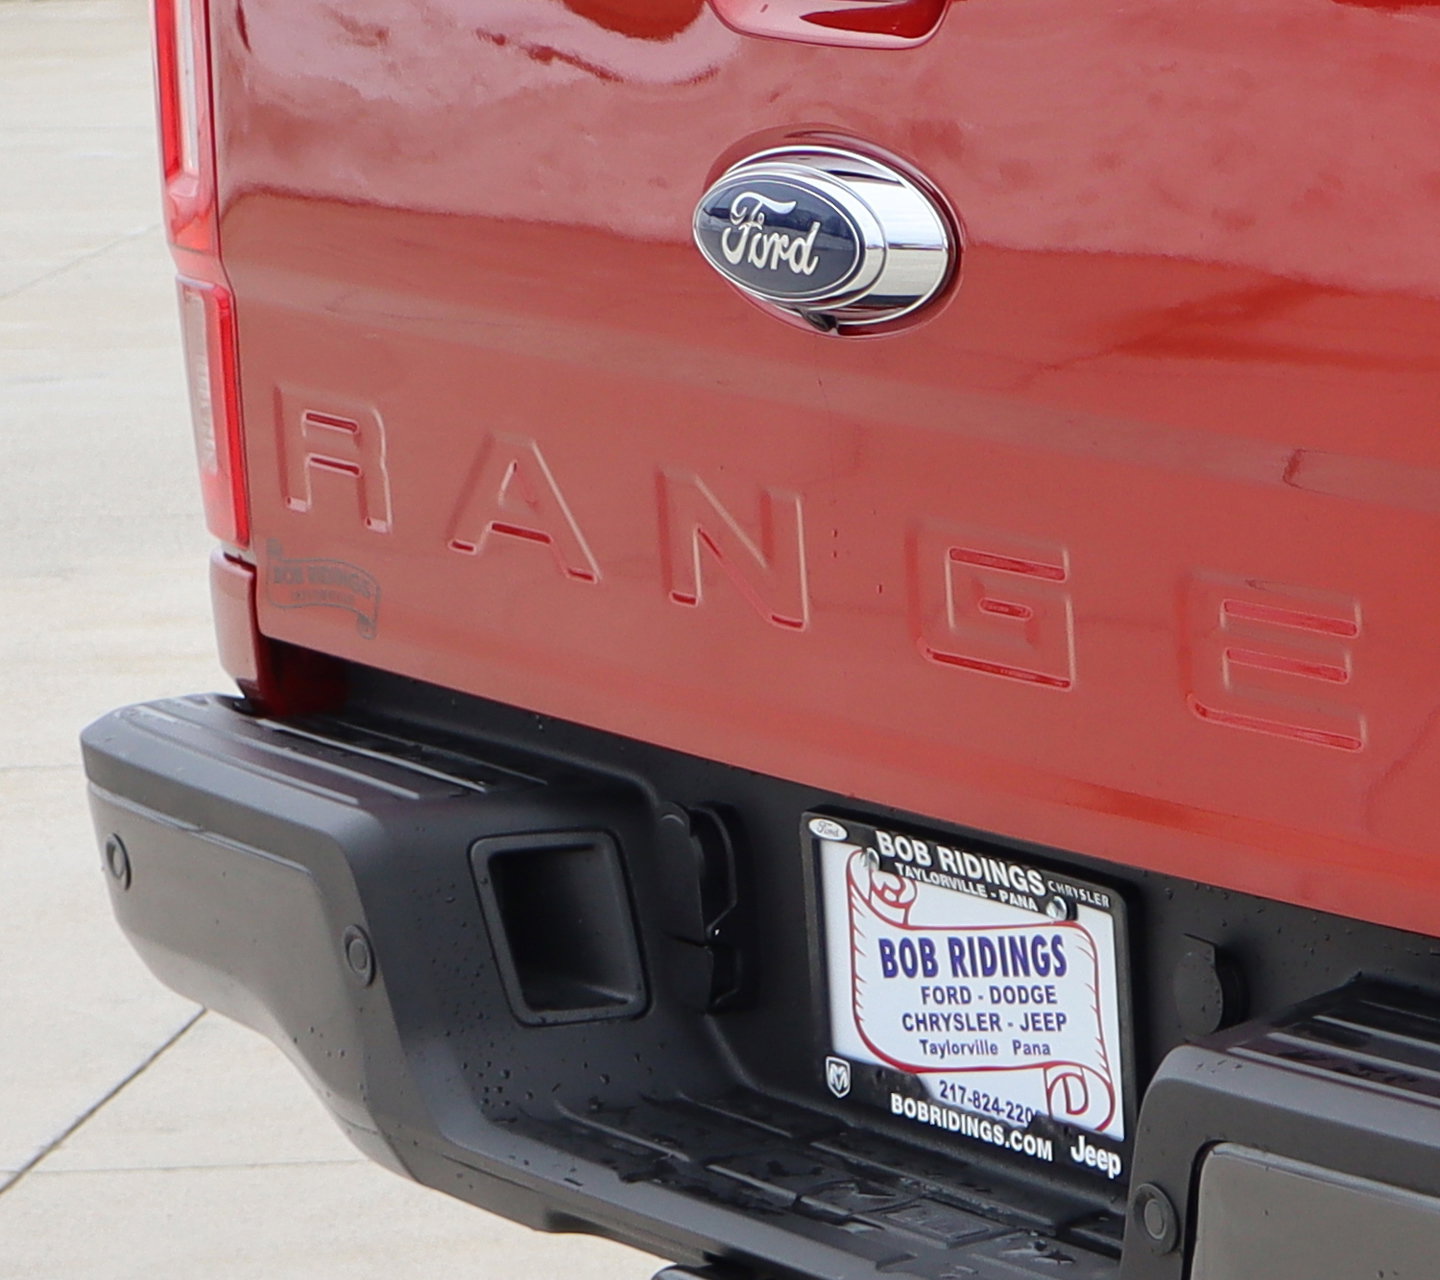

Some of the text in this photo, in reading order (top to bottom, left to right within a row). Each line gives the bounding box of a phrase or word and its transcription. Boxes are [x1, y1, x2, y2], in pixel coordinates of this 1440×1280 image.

[721, 191, 821, 276] Ford
[875, 830, 1047, 898] BOB RIDINGS
[894, 862, 988, 900] TAYLORVILLE
[1000, 892, 1039, 913] PANA
[1048, 879, 1110, 909] CHRYSLER
[878, 934, 1068, 979] BOB RIDINGS
[921, 985, 972, 1006] FORD
[989, 984, 1058, 1005] DODGE
[902, 1012, 1003, 1033] CHRYSLER
[1019, 1011, 1067, 1033] JEEP
[919, 1038, 1052, 1059] Taylorville Pana
[938, 1079, 1042, 1125] 217-824-220
[890, 1092, 1054, 1163] BOBRIDINGS.COM
[1070, 1135, 1123, 1180] Jeep
